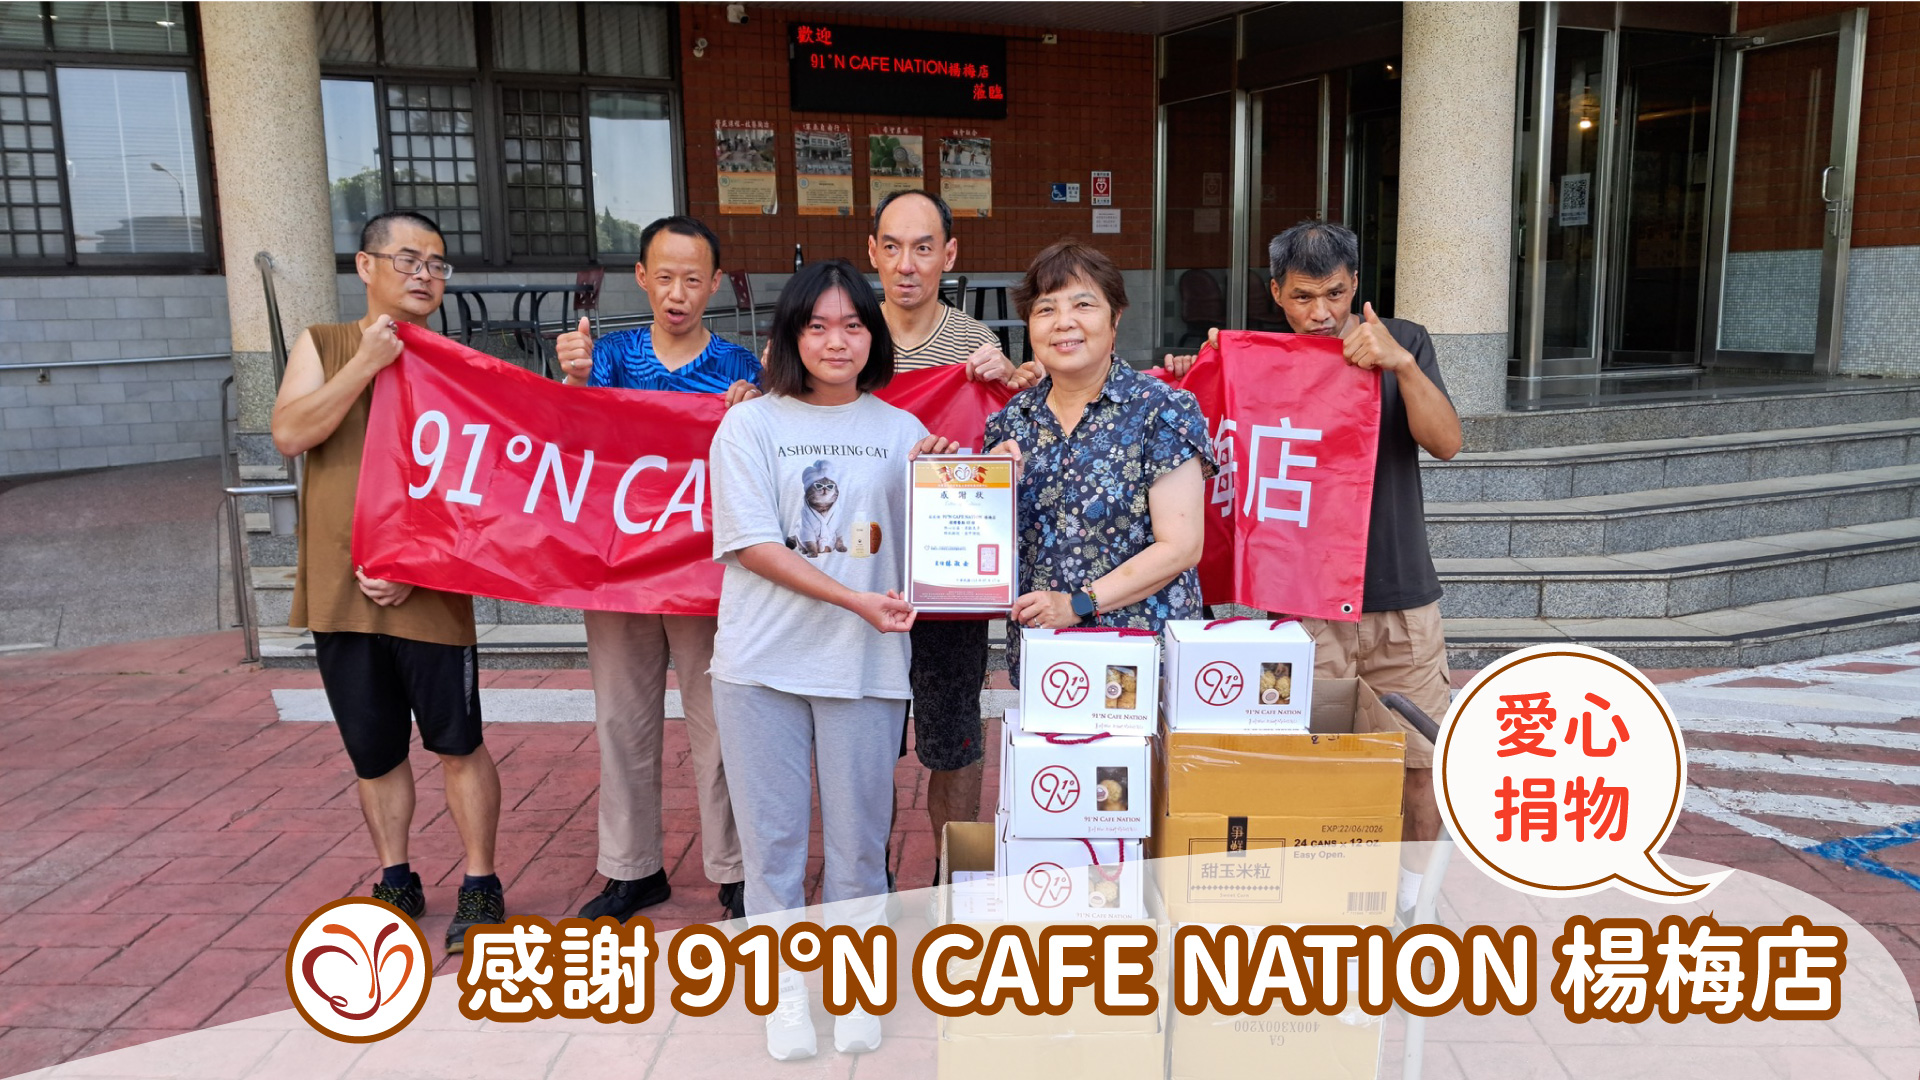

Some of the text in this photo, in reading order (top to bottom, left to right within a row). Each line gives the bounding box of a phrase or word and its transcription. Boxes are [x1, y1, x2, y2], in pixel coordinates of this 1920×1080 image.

[797, 25, 832, 45] 歡迎
[849, 55, 890, 72] CAFE
[866, 446, 889, 459] CAT
[408, 409, 595, 524] 91°N
[1321, 825, 1384, 833] EXP:22/06/2026
[1294, 839, 1308, 848] 24
[1310, 840, 1337, 848] CANS
[1350, 838, 1363, 847] 12
[1293, 850, 1346, 860] Easy Open.
[1201, 863, 1271, 880] 甜玉米粒
